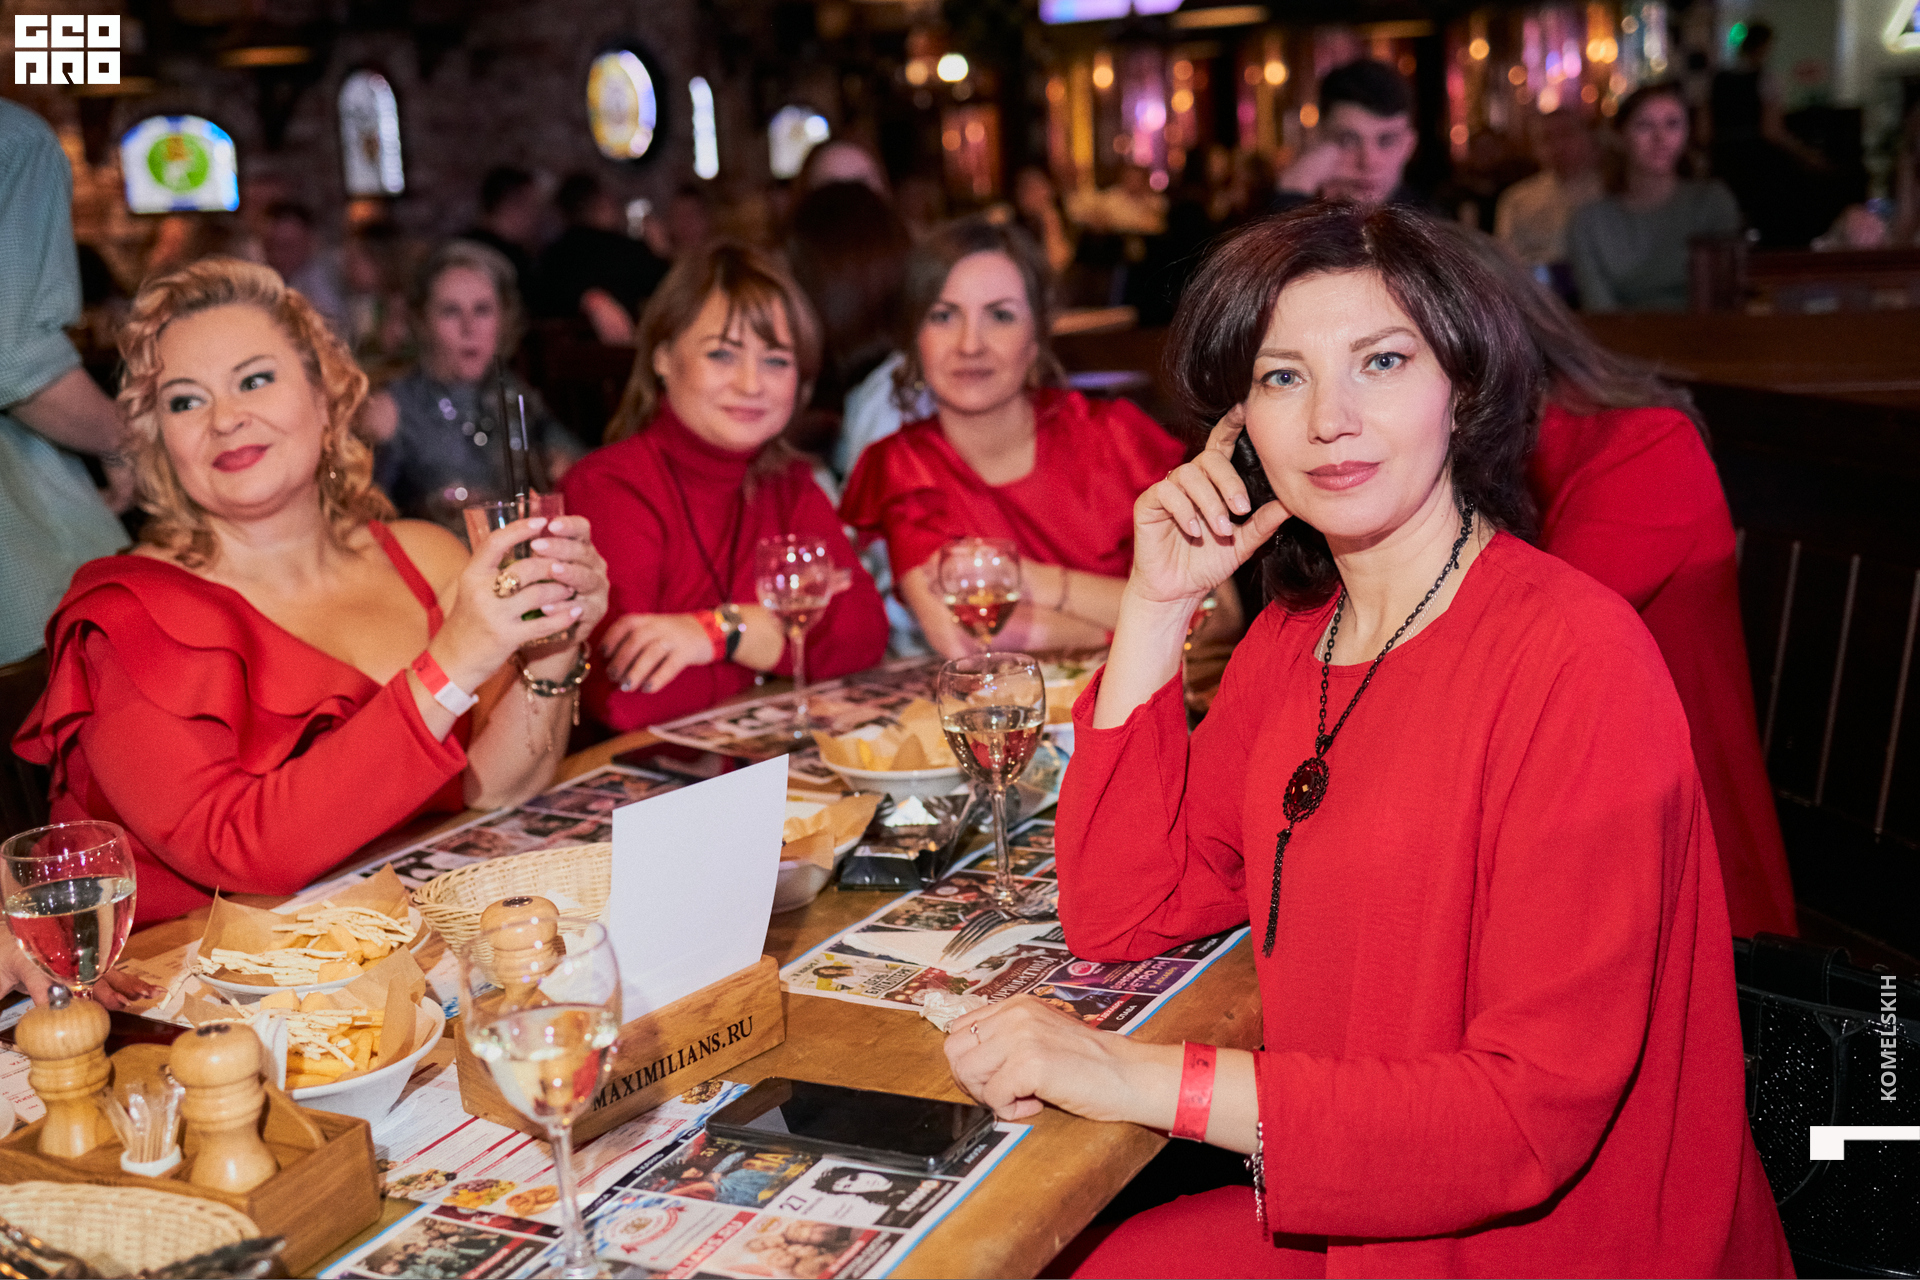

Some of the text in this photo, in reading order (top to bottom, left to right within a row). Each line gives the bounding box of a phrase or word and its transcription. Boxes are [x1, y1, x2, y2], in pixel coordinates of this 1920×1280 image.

[1124, 968, 1159, 992] РЕТРО
[1115, 1004, 1138, 1022] СЛАВА
[593, 1015, 754, 1112] MAXIMILIANS.RU
[779, 1194, 808, 1212] 27
